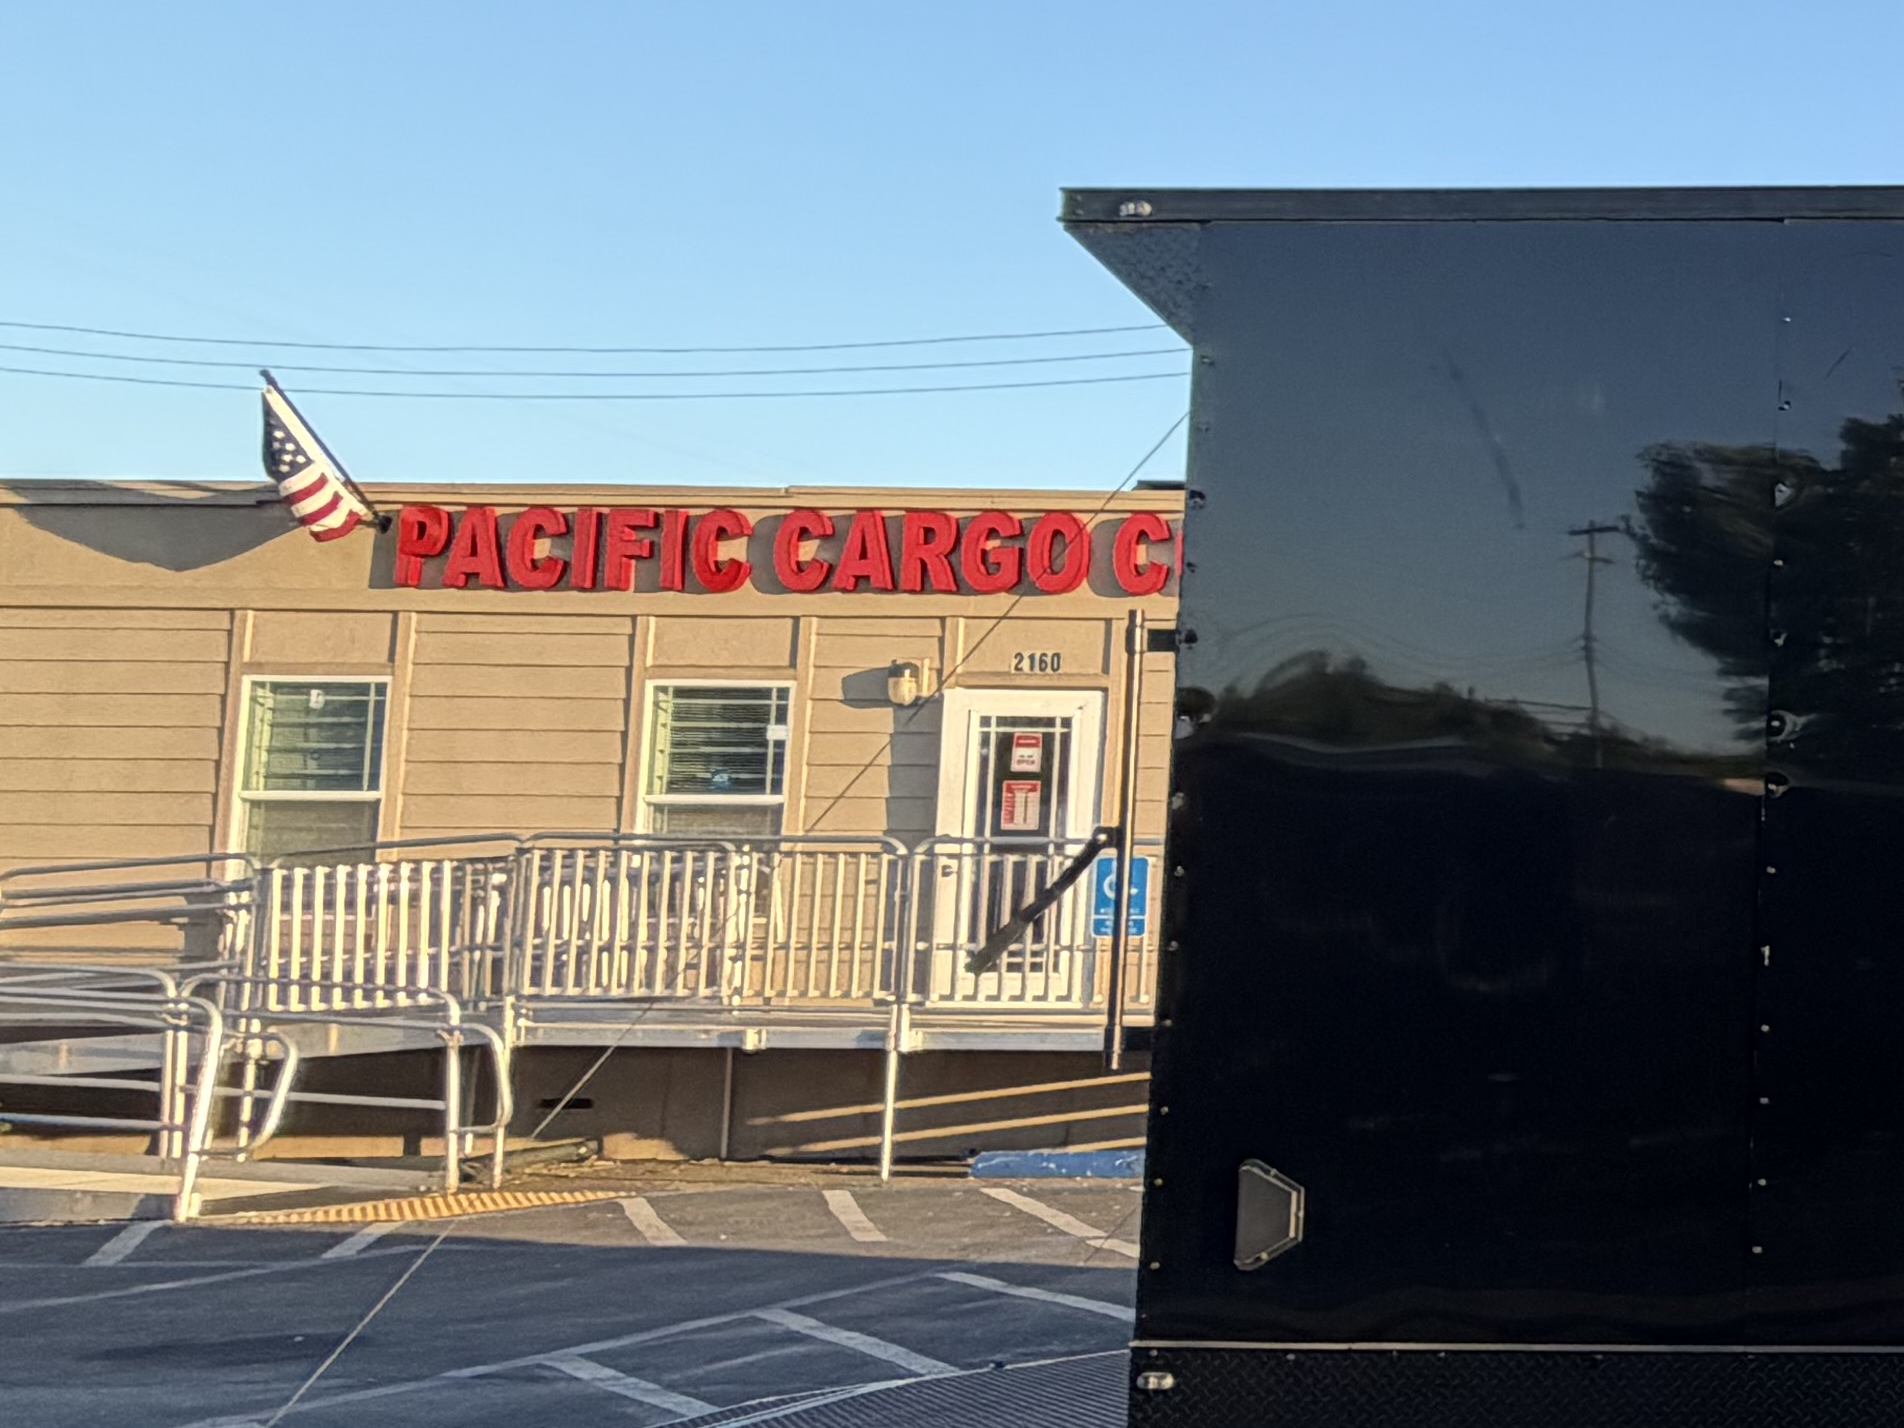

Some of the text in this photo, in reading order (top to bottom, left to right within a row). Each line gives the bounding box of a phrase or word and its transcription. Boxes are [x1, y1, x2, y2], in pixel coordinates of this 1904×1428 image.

[394, 505, 753, 592] PACIFIC
[773, 508, 1091, 594] CARGO
[1013, 652, 1062, 672] 2160
